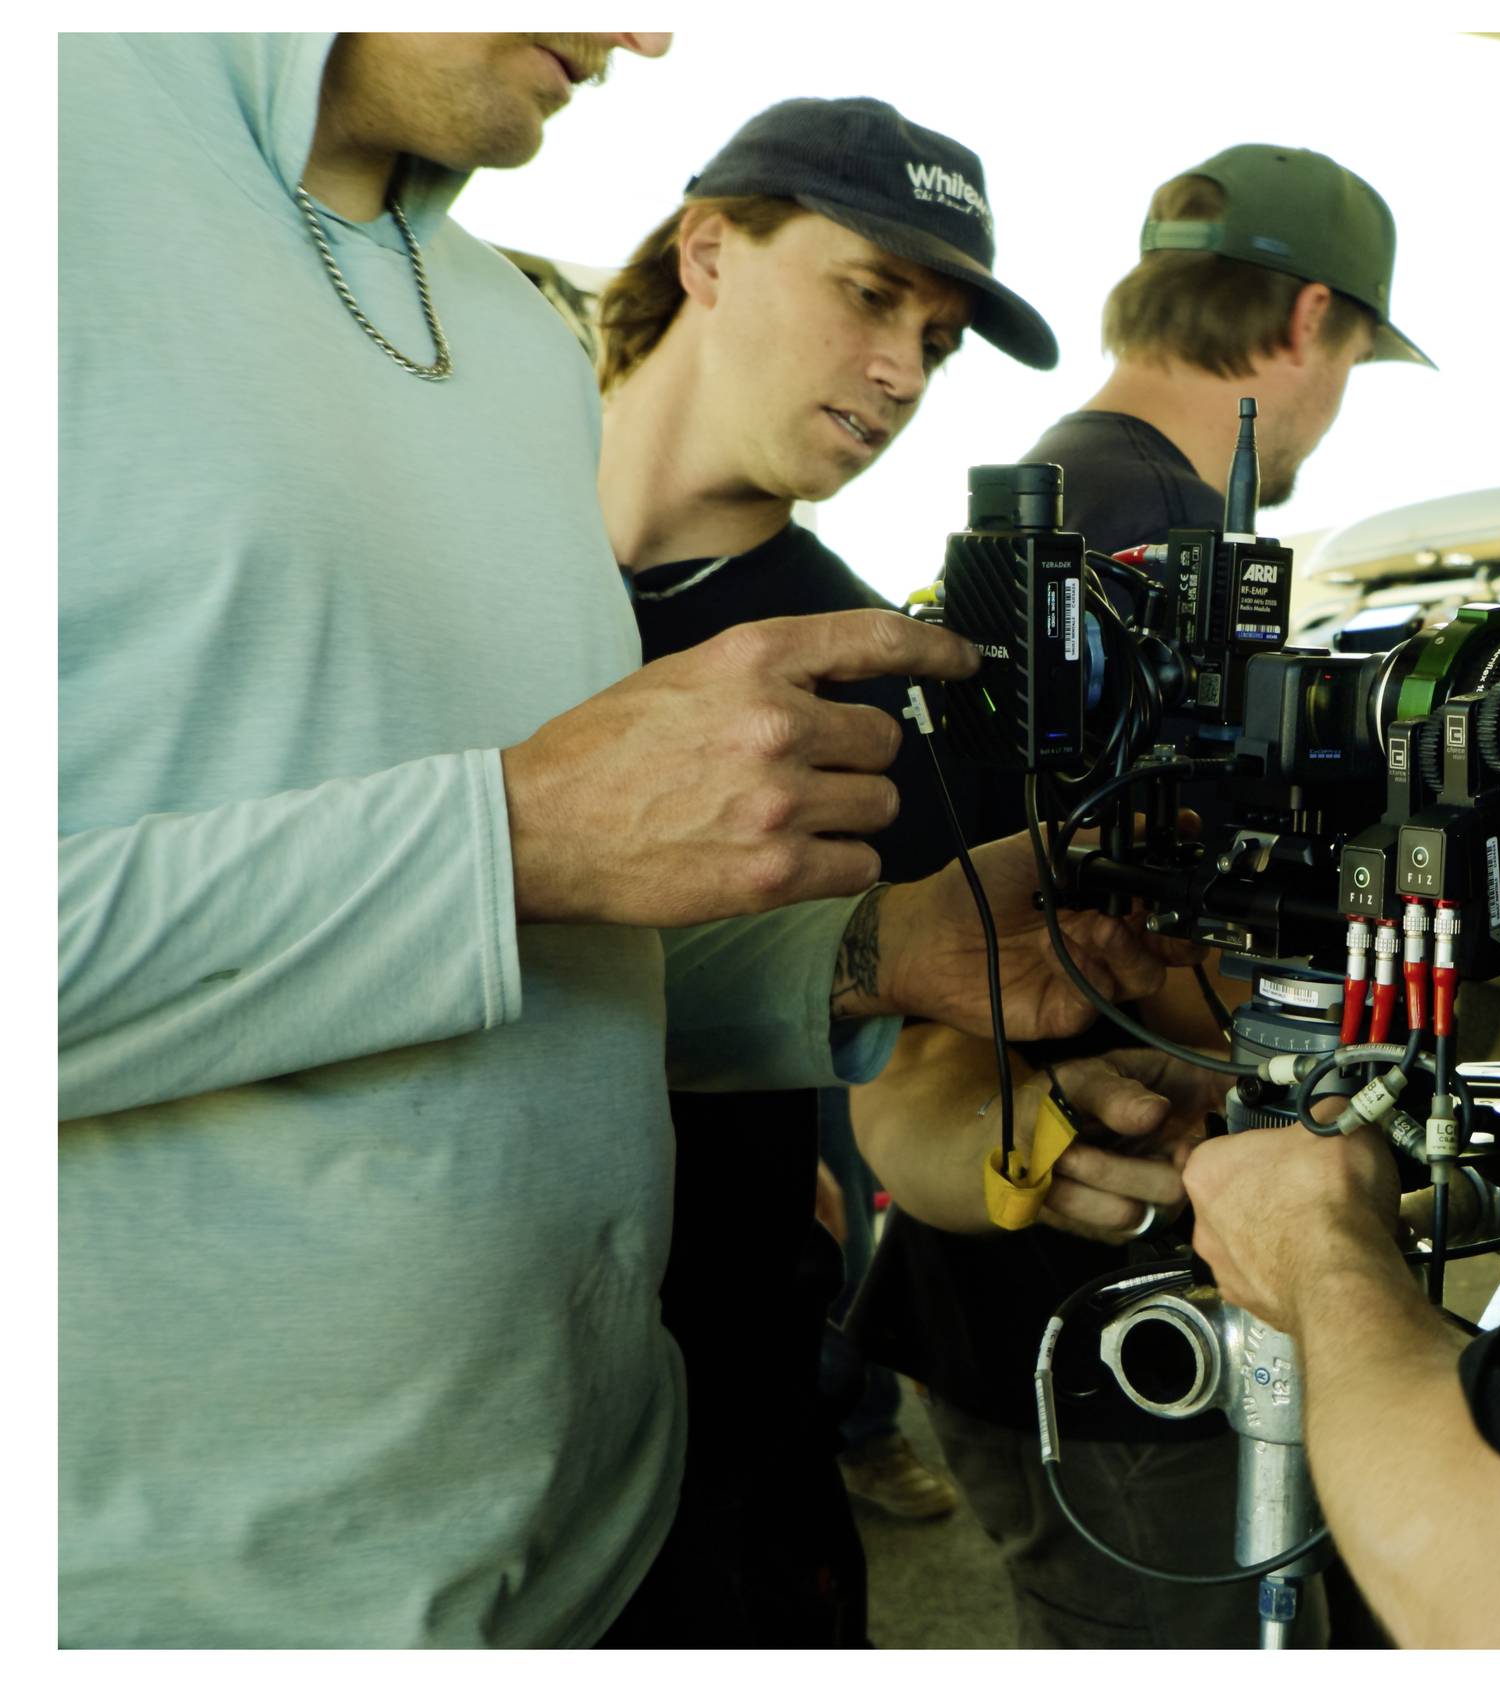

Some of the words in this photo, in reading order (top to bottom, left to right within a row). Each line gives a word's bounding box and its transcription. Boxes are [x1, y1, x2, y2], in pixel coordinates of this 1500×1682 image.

[1041, 561, 1072, 569] TERADEK
[1242, 563, 1278, 583] ARRI
[1241, 585, 1268, 596] RF-EMIP
